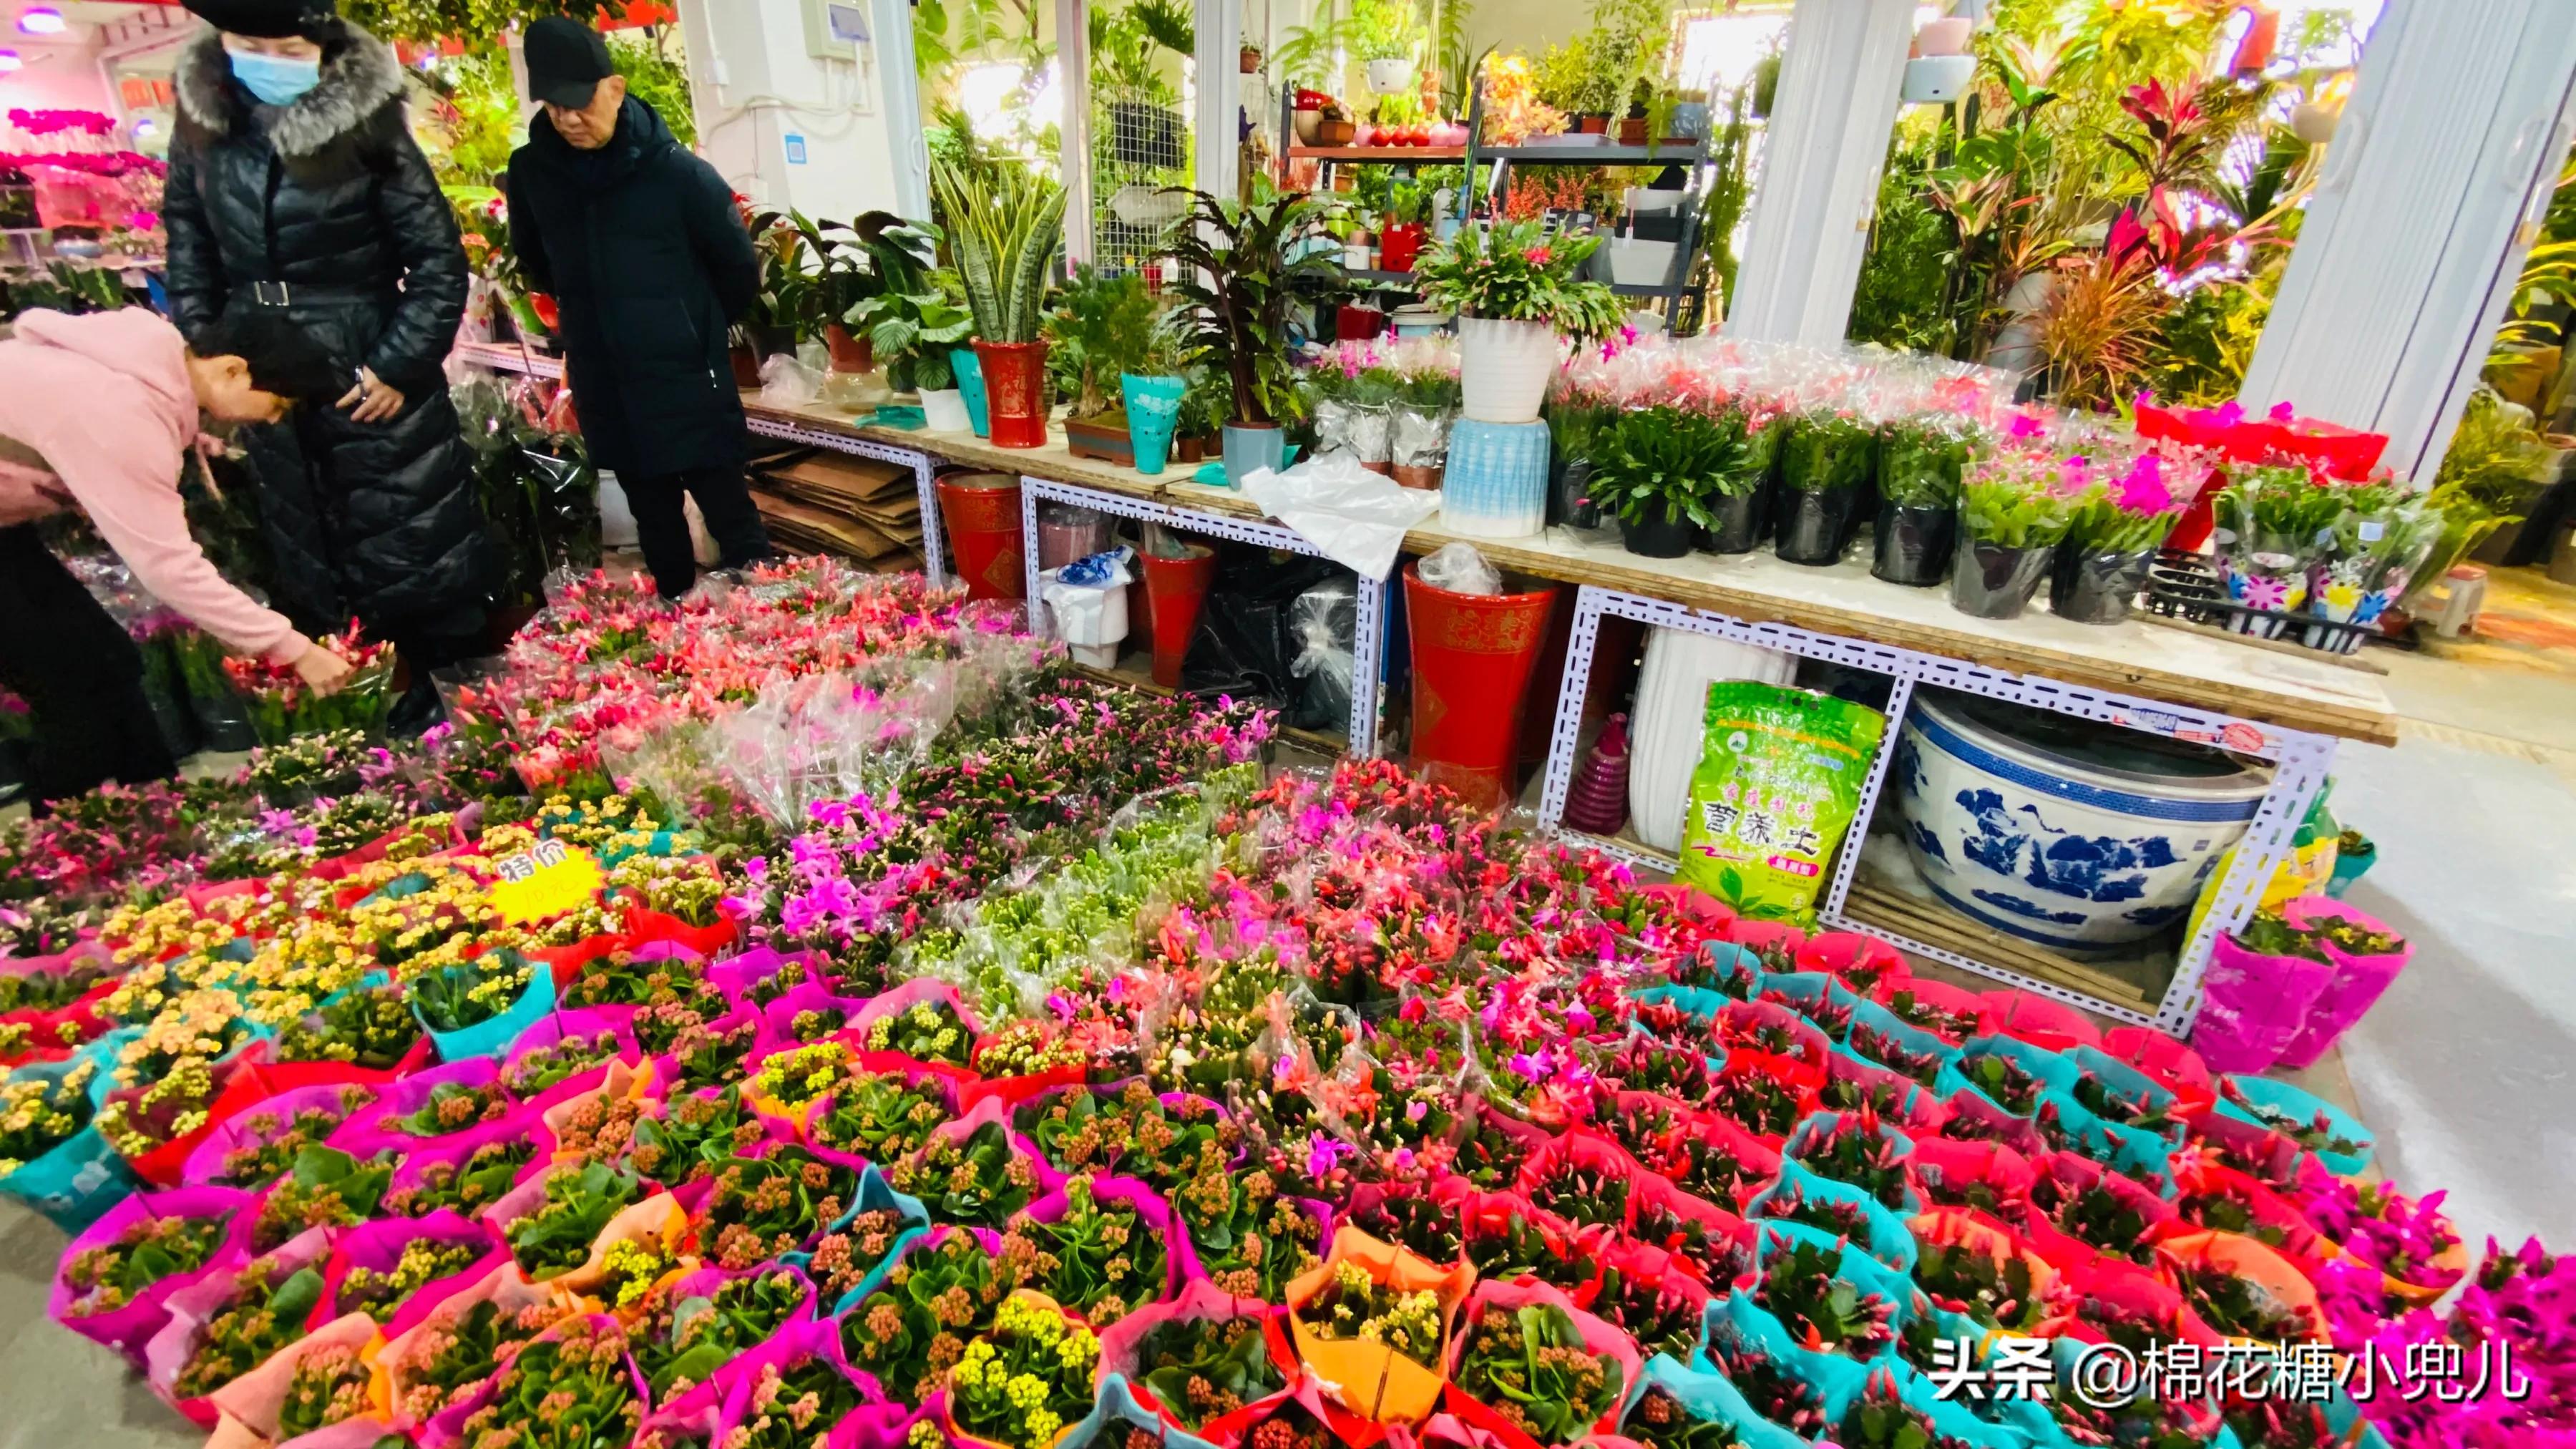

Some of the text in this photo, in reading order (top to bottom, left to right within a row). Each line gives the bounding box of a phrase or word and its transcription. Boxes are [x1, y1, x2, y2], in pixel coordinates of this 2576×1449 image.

[1706, 802, 1818, 856] 营养土
[498, 840, 569, 882] 特价
